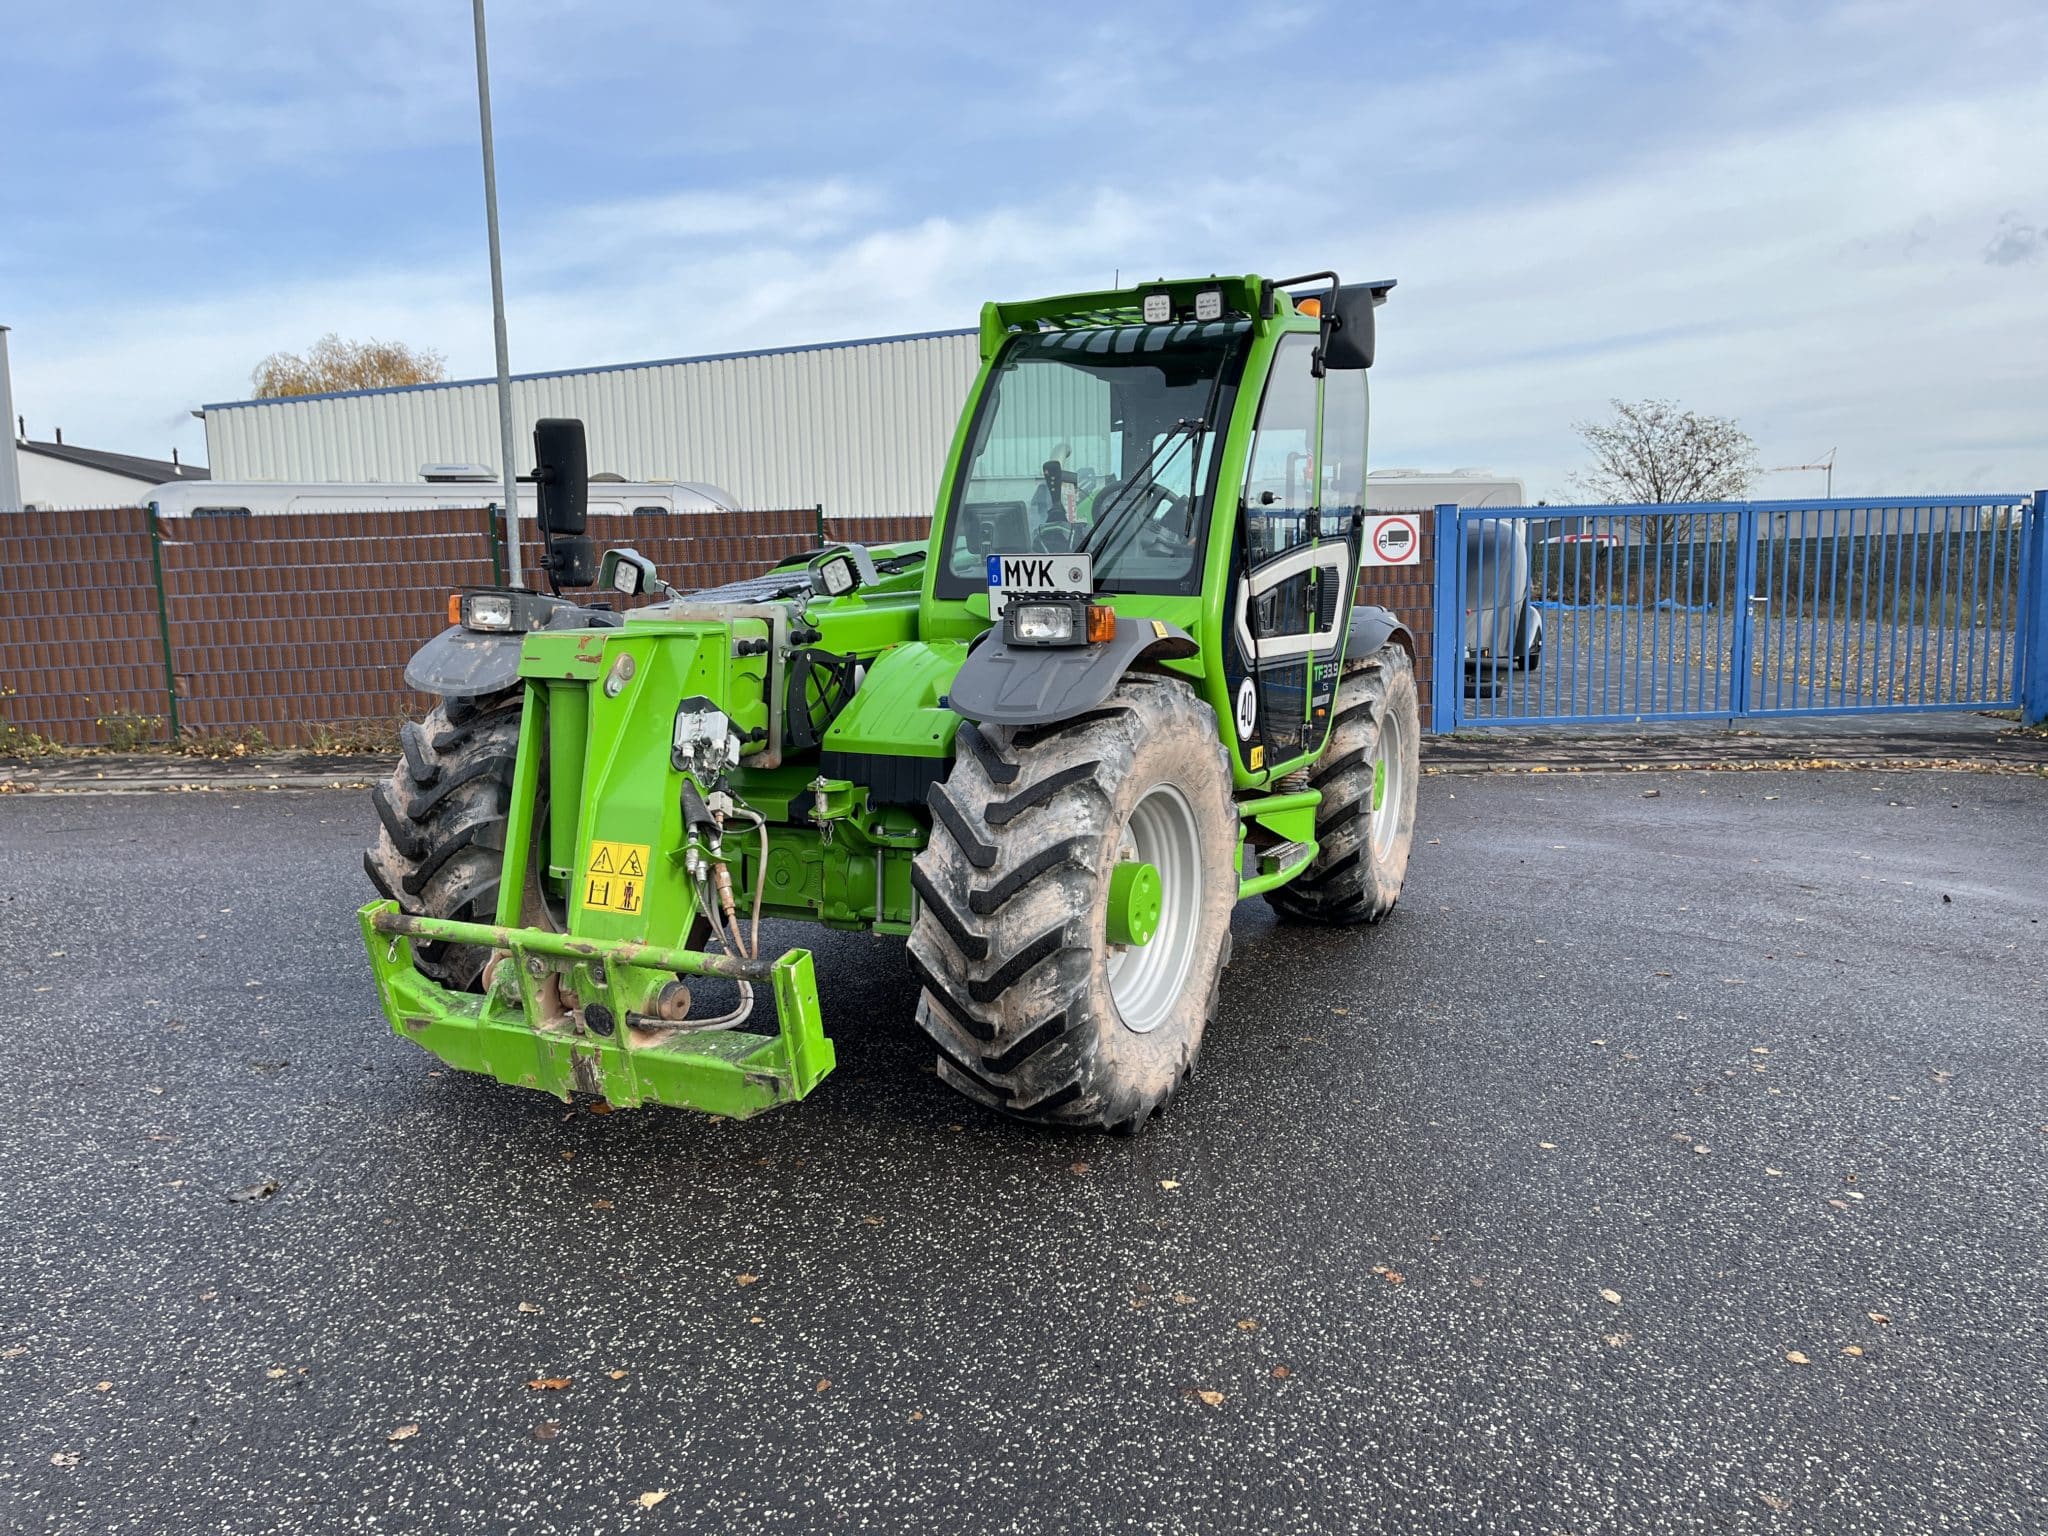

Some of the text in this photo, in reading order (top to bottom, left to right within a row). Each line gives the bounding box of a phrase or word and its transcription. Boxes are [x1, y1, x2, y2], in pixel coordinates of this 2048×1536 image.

[992, 574, 998, 583] D
[1004, 560, 1055, 587] MYK
[1313, 662, 1339, 681] TF33.9
[1241, 690, 1253, 727] 40
